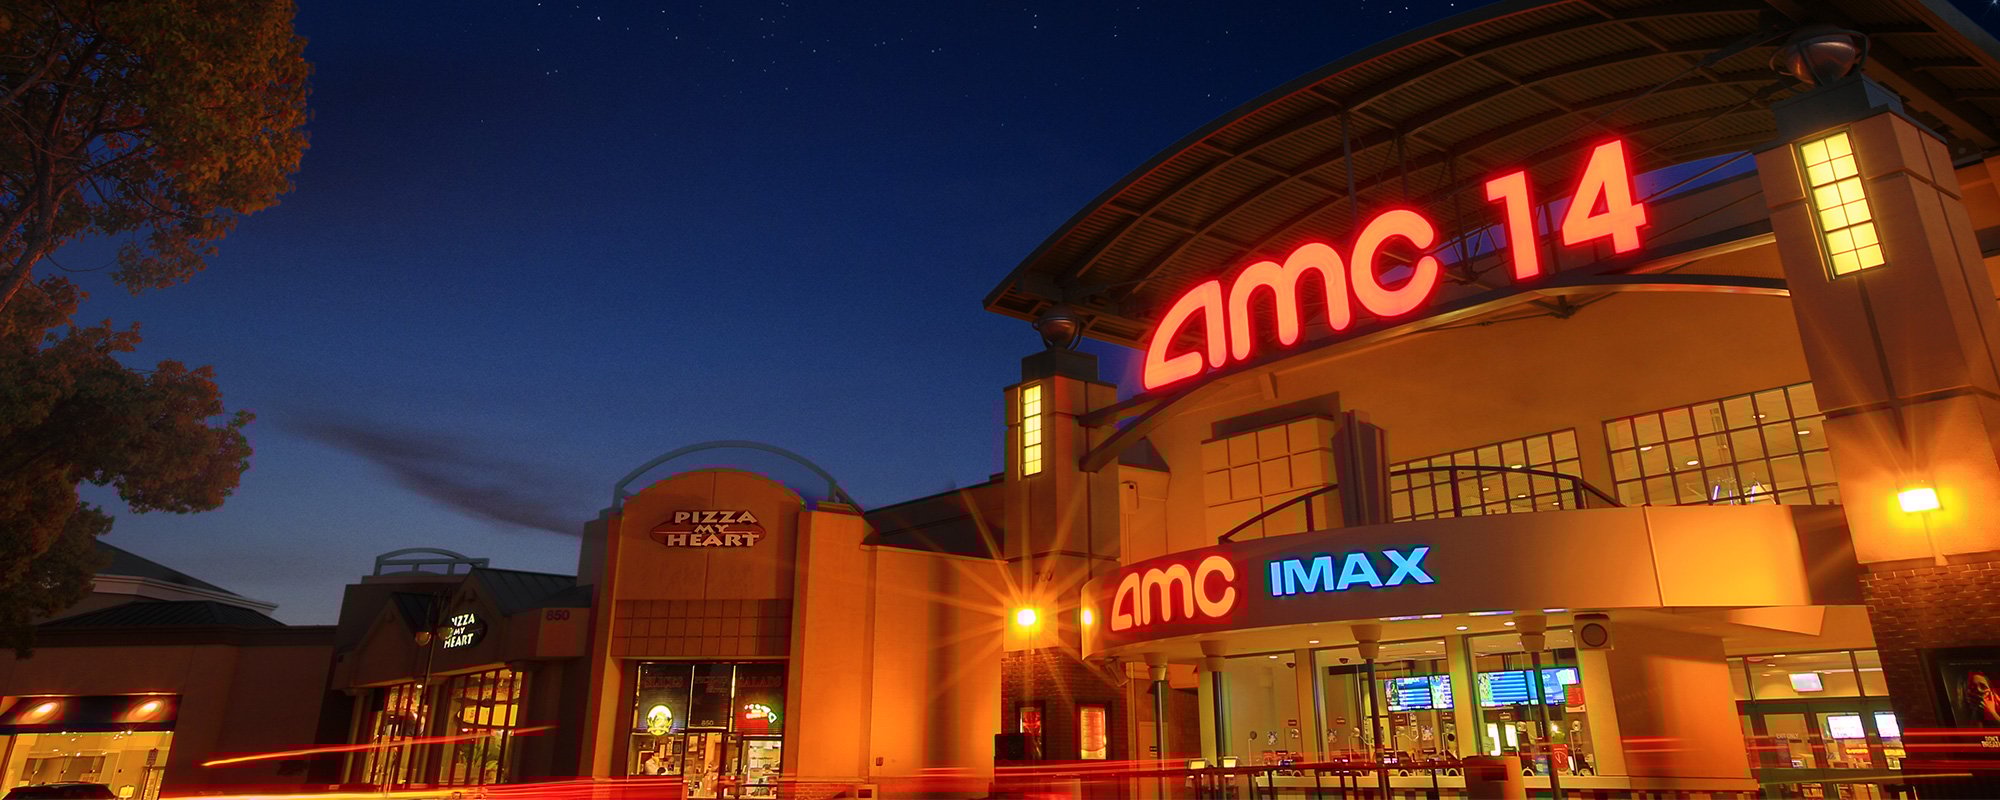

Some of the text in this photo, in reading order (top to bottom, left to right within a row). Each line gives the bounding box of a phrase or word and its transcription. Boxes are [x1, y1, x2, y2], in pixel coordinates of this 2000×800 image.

[1484, 139, 1647, 280] 14
[674, 510, 758, 523] PIZZA
[694, 524, 729, 533] MY
[667, 533, 760, 547] HEART
[1270, 545, 1435, 597] IMAX
[546, 609, 570, 621] 850
[453, 626, 466, 636] MY
[443, 632, 474, 649] HEART
